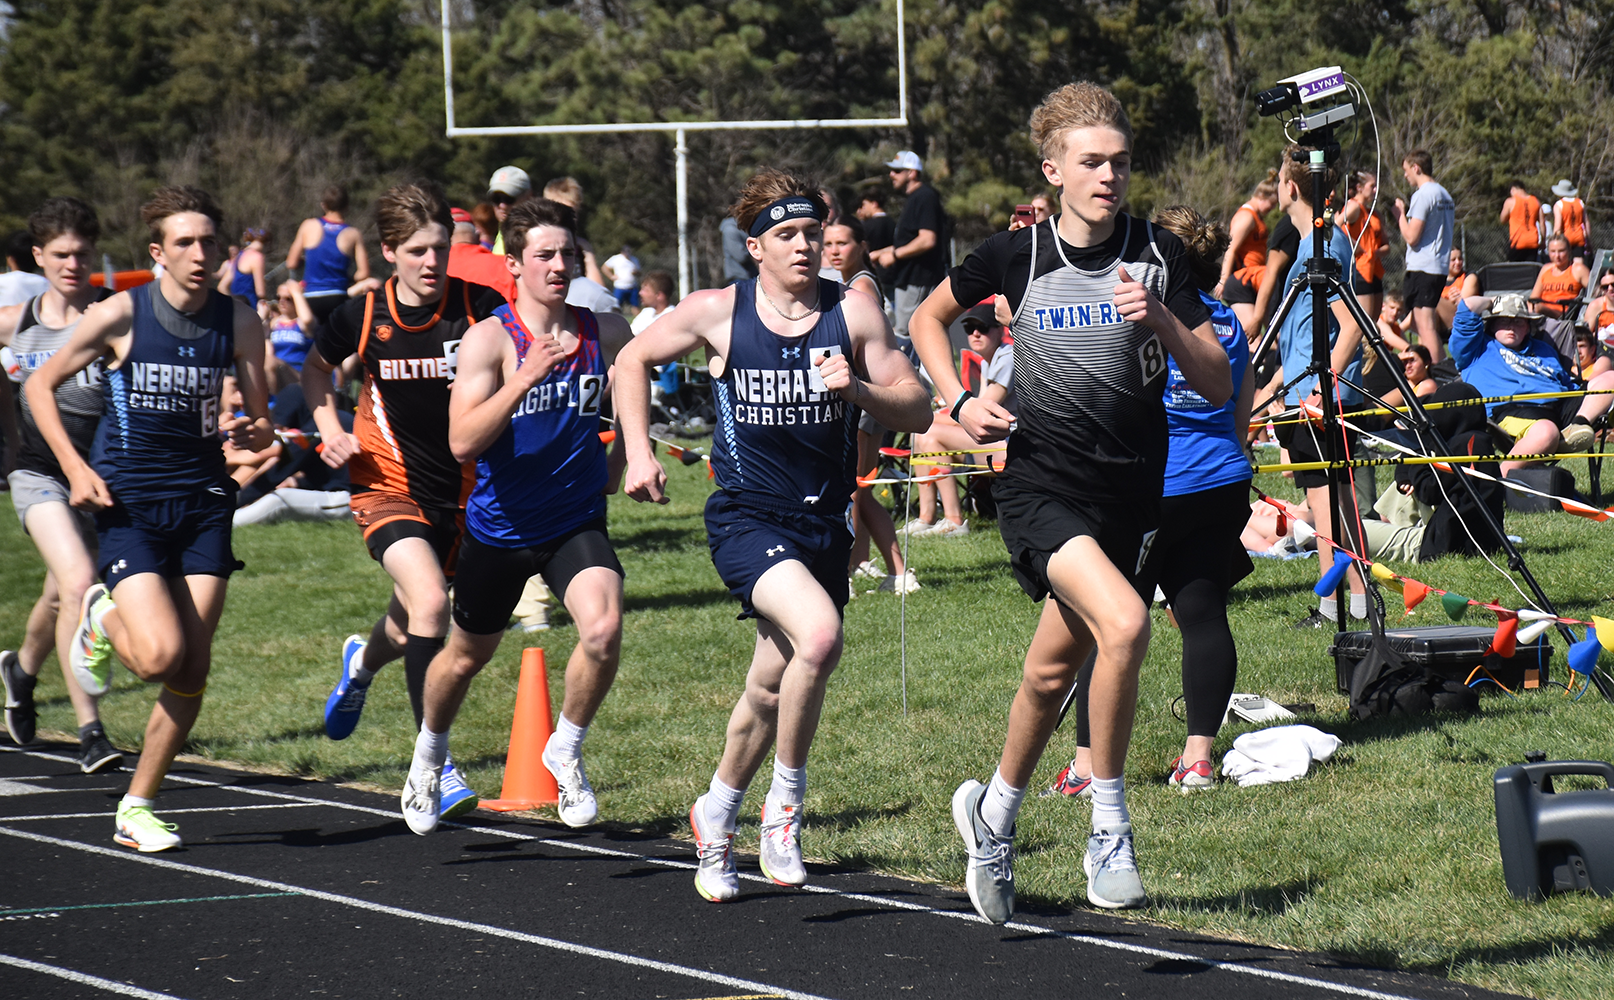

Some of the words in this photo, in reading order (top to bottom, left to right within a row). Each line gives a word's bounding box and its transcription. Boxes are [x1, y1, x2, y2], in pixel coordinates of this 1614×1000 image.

[1311, 76, 1339, 92] LYNX
[1034, 303, 1093, 331] TWIN
[1099, 302, 1123, 325] RI
[378, 358, 448, 380] GILTNE
[1143, 337, 1162, 379] 8
[129, 392, 200, 412] CHRIST
[511, 383, 552, 419] IGH
[555, 380, 579, 408] PL
[582, 377, 600, 413] 2
[733, 368, 839, 404] NEBRA
[204, 399, 215, 434] 5
[735, 401, 843, 426] CHRISTIAN
